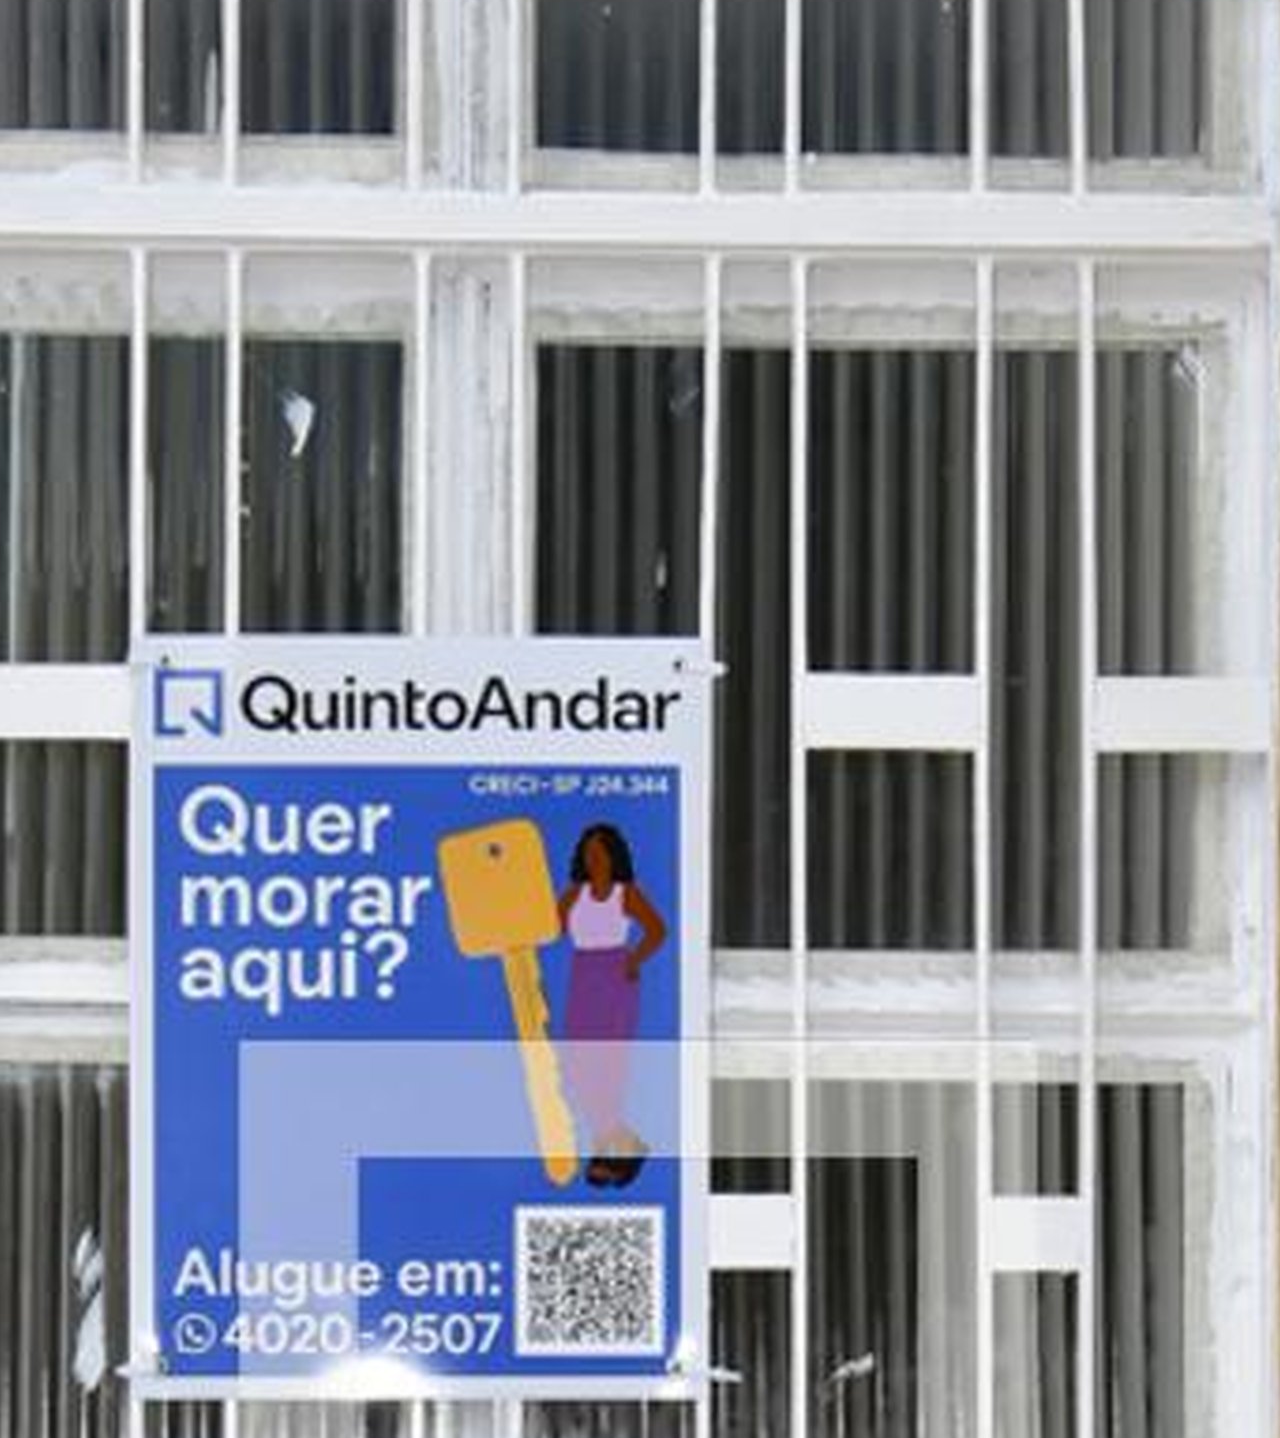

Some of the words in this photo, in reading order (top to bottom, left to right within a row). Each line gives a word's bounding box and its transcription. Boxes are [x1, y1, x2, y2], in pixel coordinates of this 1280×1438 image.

[240, 675, 681, 733] QuintoAndar
[179, 784, 392, 856] Quer
[181, 874, 432, 927] morar
[179, 929, 409, 1016] aqui?
[173, 1248, 382, 1309] Alugue
[397, 1259, 502, 1297] em:
[222, 1312, 503, 1355] 4020-2507
